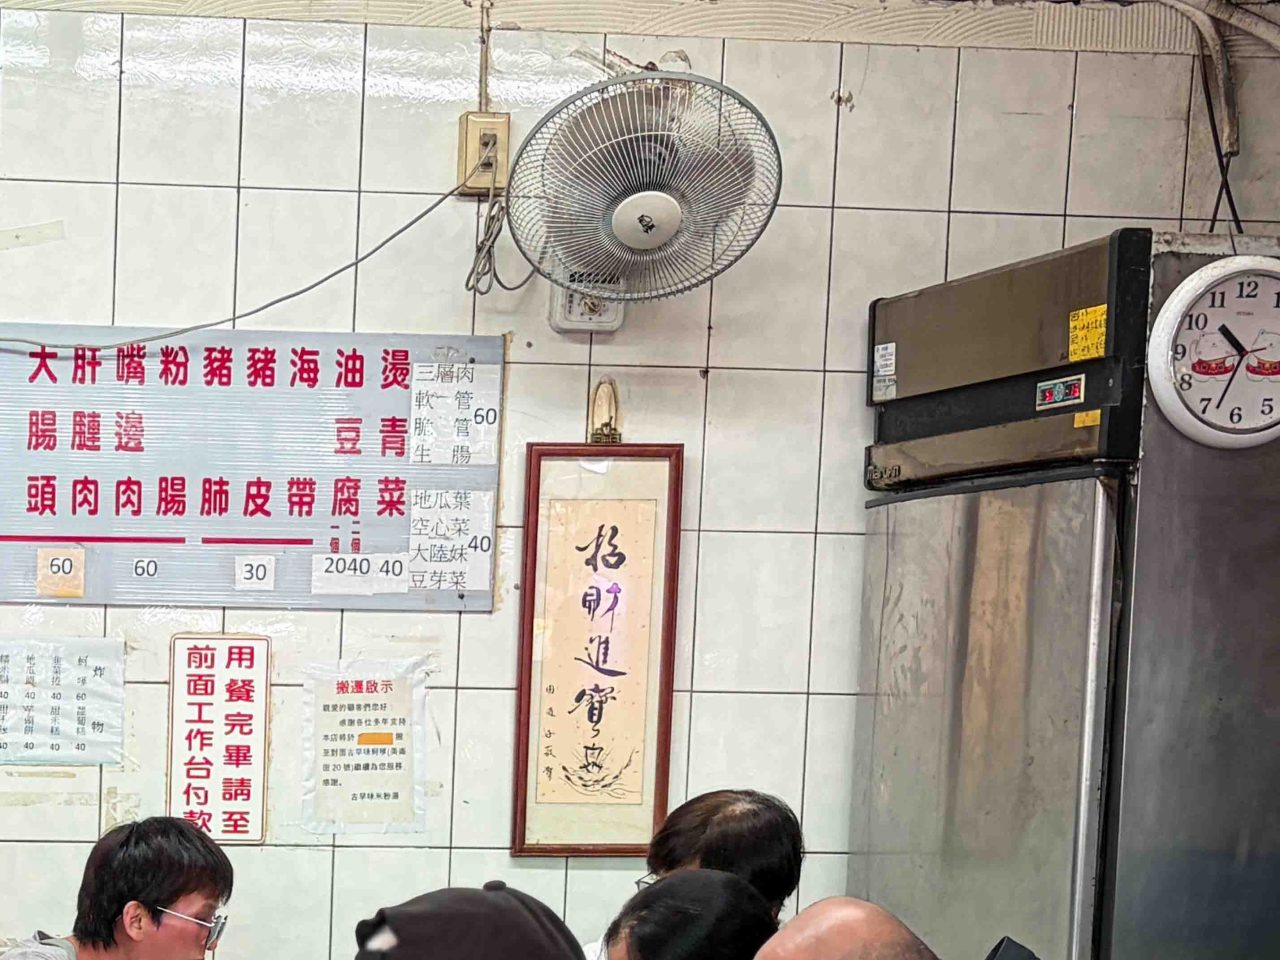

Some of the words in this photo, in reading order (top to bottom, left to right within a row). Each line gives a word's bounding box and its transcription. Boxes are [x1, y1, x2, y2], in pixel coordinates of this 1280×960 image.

[1236, 280, 1259, 299] 12
[1208, 291, 1226, 309] 11
[1185, 312, 1208, 331] 10
[1174, 343, 1187, 362] 9
[415, 363, 475, 384] 三層肉
[1179, 373, 1193, 391] 8
[1199, 397, 1212, 415] 7
[1229, 406, 1242, 424] 6
[1260, 398, 1273, 416] 5
[474, 407, 498, 425] 60
[26, 345, 57, 517] 大腸頭
[115, 345, 147, 517] 嘴邊肉
[156, 346, 190, 517] 粉腸
[199, 346, 234, 517] 豬肺
[242, 347, 277, 517] 豬皮
[287, 347, 320, 517] 海帶
[331, 348, 365, 517] 油豆腐
[376, 349, 410, 518] 燙青菜
[412, 490, 472, 511] 地瓜葉
[411, 516, 471, 538] 空心菜
[409, 542, 469, 564] 大陸妹
[468, 535, 491, 553] 40
[49, 557, 73, 575] 60
[133, 559, 158, 577] 60
[242, 563, 267, 581] 30
[324, 557, 346, 574] 20
[347, 557, 371, 575] 40
[379, 559, 403, 577] 40
[408, 569, 468, 591] 豆芽菜
[567, 523, 629, 740] 招財進寶
[24, 691, 36, 700] 40
[51, 692, 62, 701] 40
[76, 692, 87, 701] 60
[23, 742, 35, 750] 40
[50, 743, 61, 751] 40
[75, 743, 86, 751] 40
[183, 644, 217, 834] 前面工作台付款
[220, 645, 256, 835] 用餐完畢請至
